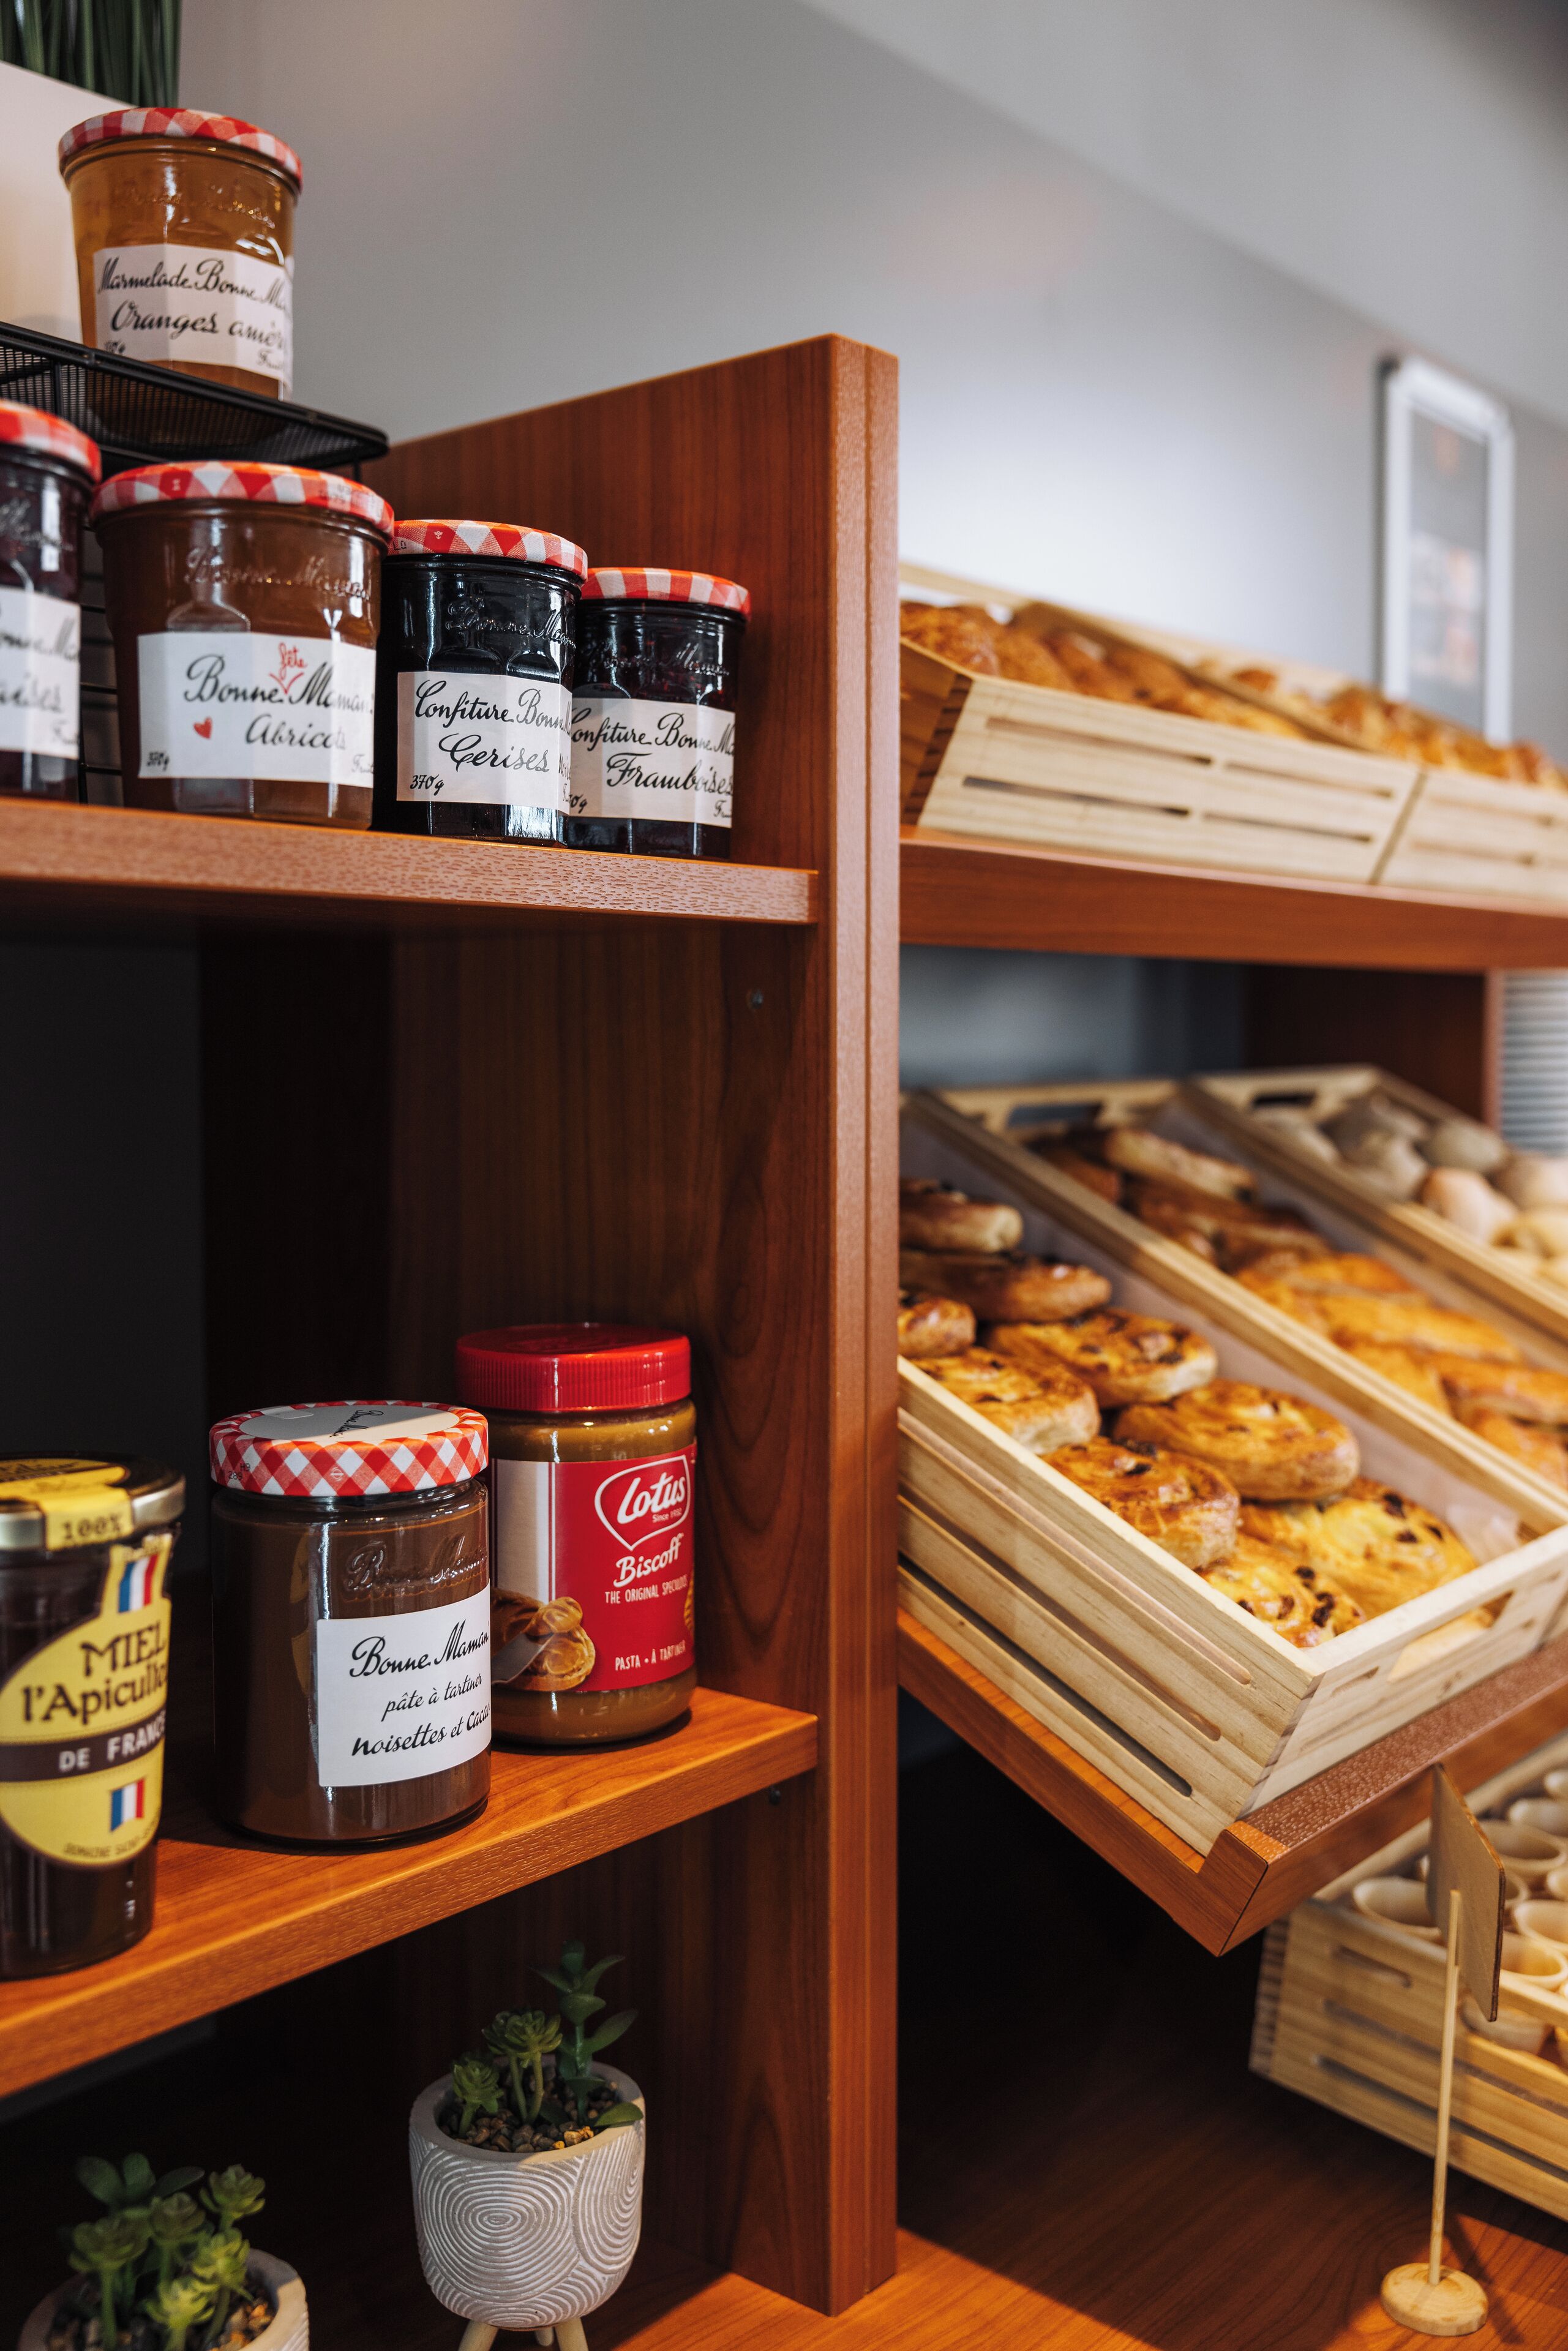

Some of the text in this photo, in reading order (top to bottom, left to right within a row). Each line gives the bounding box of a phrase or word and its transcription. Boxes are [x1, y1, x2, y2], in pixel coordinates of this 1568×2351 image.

[98, 256, 191, 294] Marmelade
[190, 258, 256, 299] Bonne
[110, 299, 219, 340] Oranges
[183, 654, 283, 703] Bonne
[278, 642, 309, 681] fête
[415, 680, 515, 729] Confiture
[516, 688, 564, 730] Bonne
[245, 713, 347, 751] Abricots
[655, 712, 713, 749] Bonne
[438, 733, 550, 773] Cerises
[607, 751, 734, 795] Framboises
[617, 1472, 686, 1524] Lotus
[651, 1513, 670, 1523] Since
[62, 1513, 122, 1540] 100%
[613, 1536, 682, 1588] Biscoff
[604, 1591, 621, 1604] THE
[625, 1584, 659, 1603] ORIGINAL
[80, 1622, 167, 1676] MIEL
[349, 1619, 489, 1678] Bonne Maman
[615, 1654, 641, 1671] PASTA
[381, 1673, 483, 1722] pâte à tartiner
[351, 1722, 448, 1757] noisettes
[450, 1716, 465, 1739] et
[59, 1747, 90, 1772] DE
